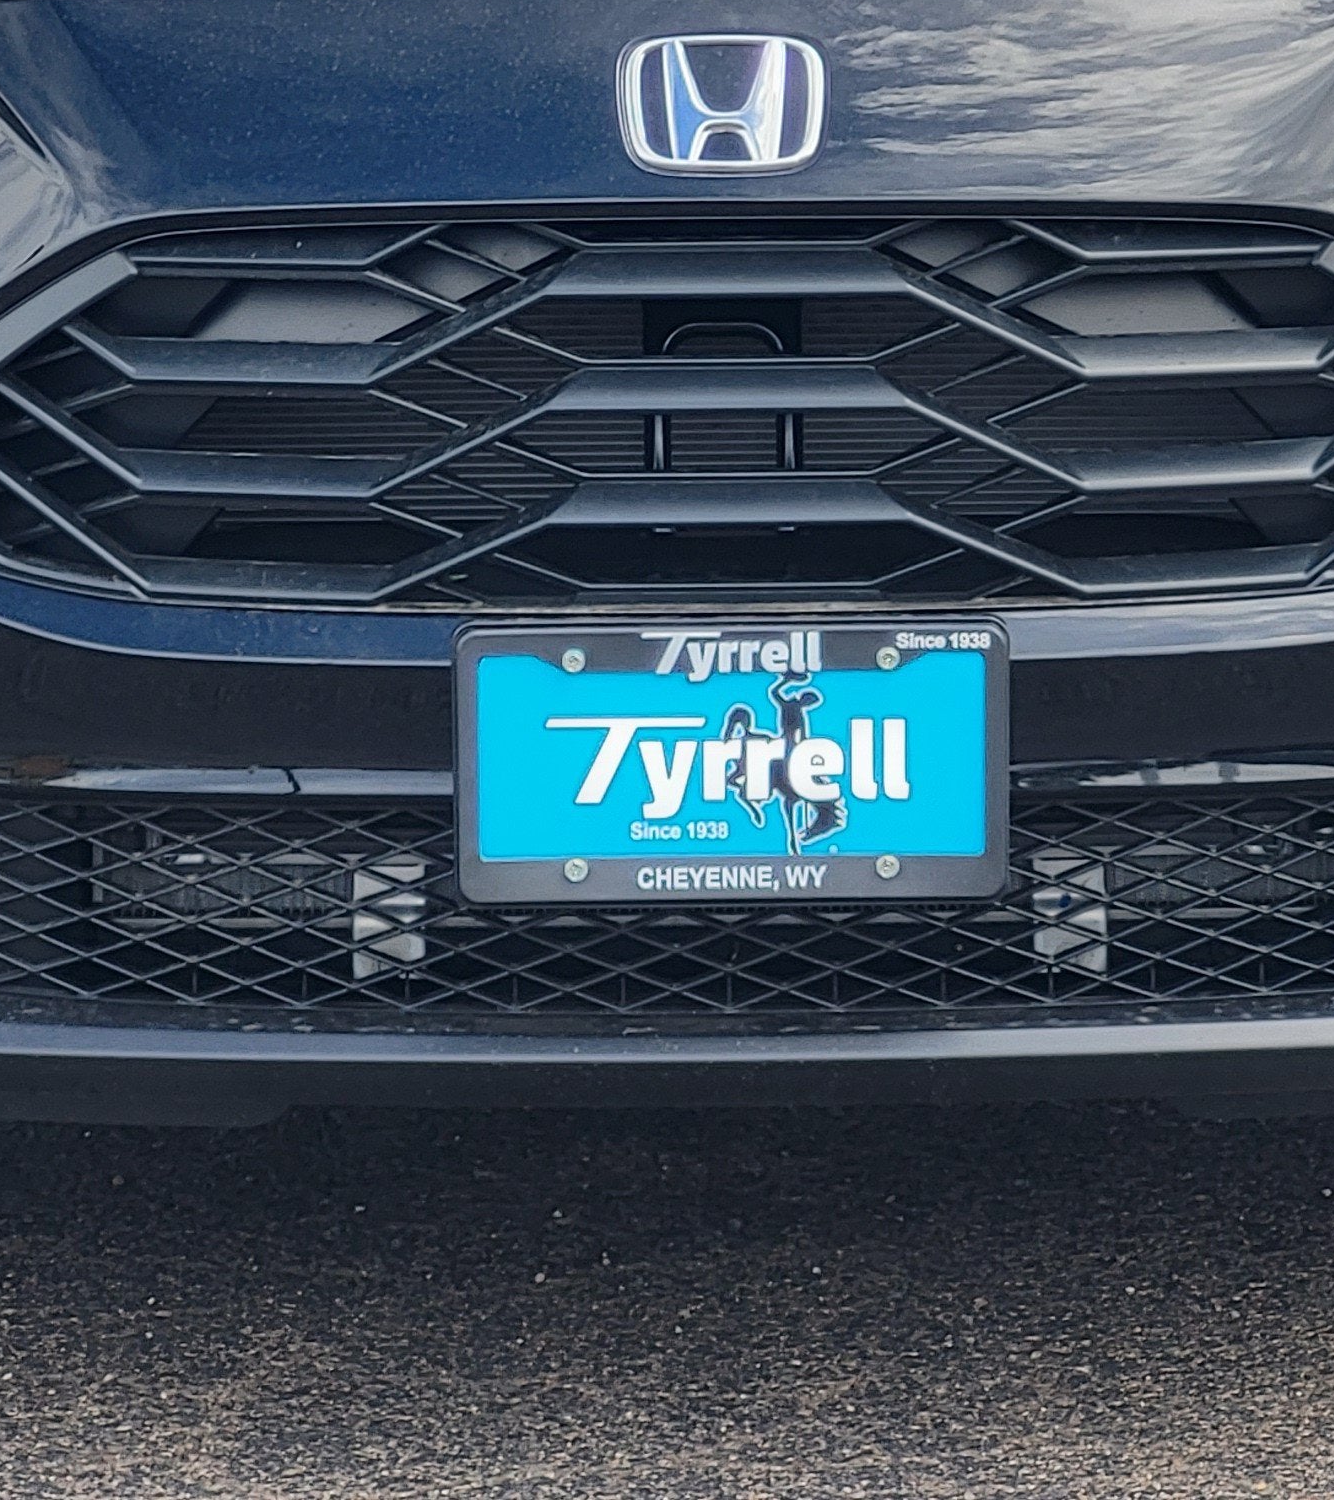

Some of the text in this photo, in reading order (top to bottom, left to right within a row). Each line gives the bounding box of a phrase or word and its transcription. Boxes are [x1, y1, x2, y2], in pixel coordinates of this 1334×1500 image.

[895, 631, 991, 650] Since 1938
[641, 630, 822, 683] Tyrrell
[544, 716, 910, 820] Tyrrell
[629, 820, 729, 841] Since 1938
[636, 864, 828, 893] CHEYENNE, WY
